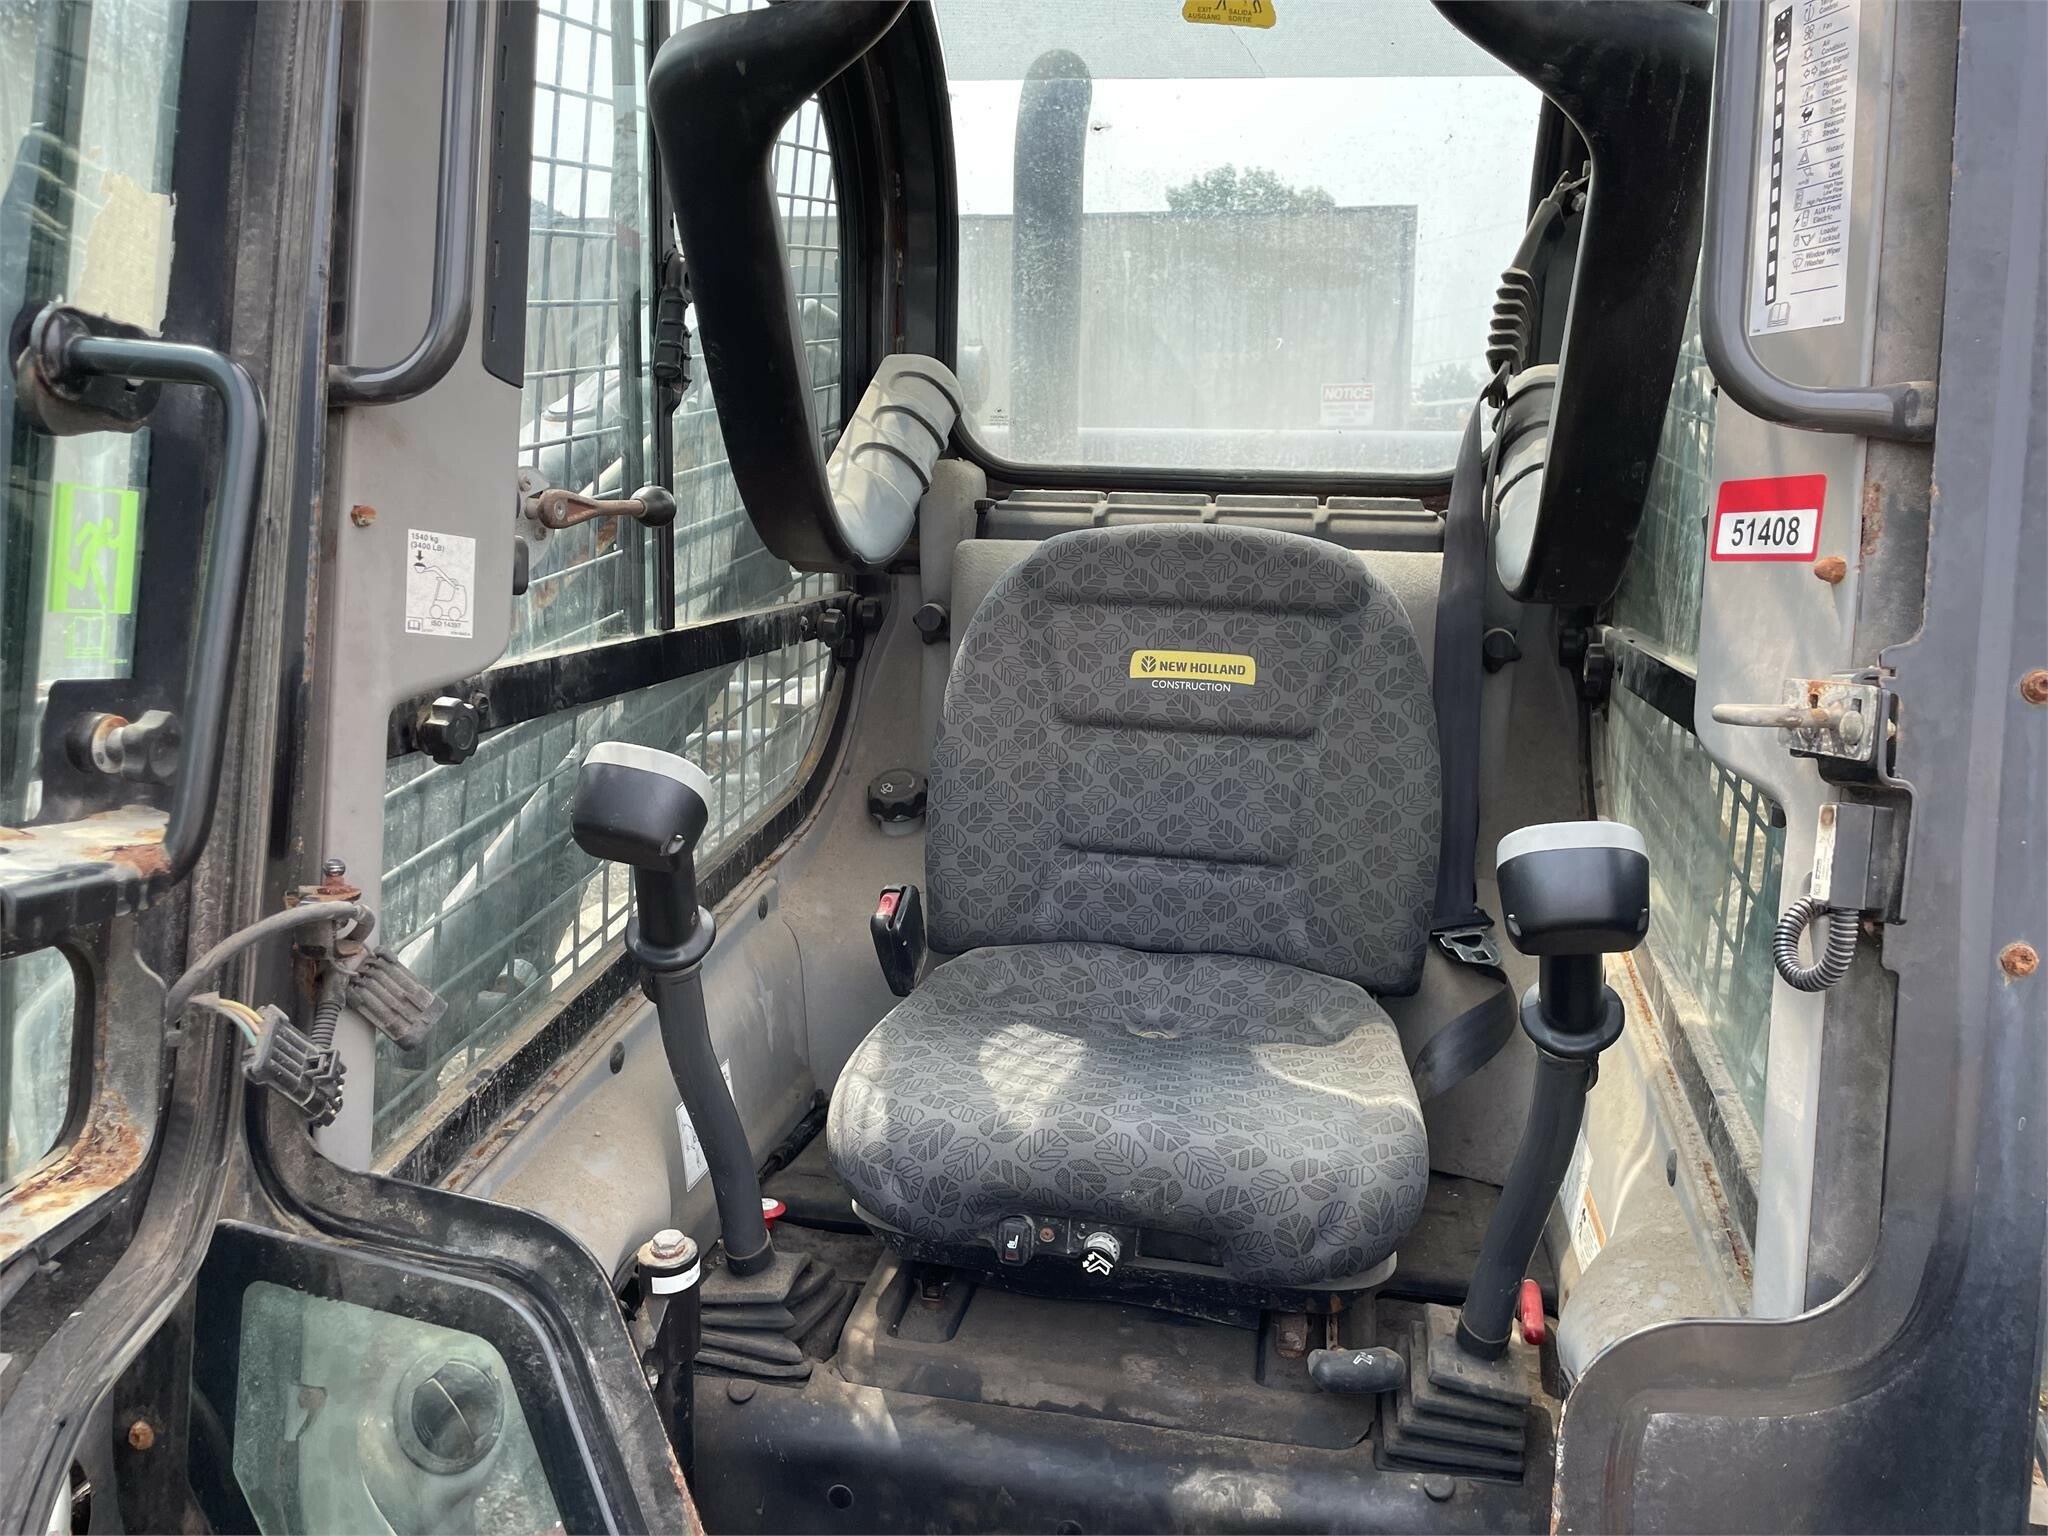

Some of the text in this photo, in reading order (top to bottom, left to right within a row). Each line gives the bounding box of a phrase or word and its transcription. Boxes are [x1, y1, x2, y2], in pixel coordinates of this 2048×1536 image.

[1823, 128, 1839, 138] Strobe
[1826, 142, 1844, 153] Hazard
[1829, 169, 1842, 178] Level
[1814, 206, 1826, 215] AUX
[1813, 214, 1832, 223] Electric
[1820, 226, 1839, 235] Loader
[1819, 234, 1840, 243] Lockout
[1806, 248, 1840, 259] Window Wiper
[1324, 387, 1371, 400] NOTICE
[1731, 516, 1800, 547] 51408
[411, 533, 438, 544] 1540 kg
[411, 542, 431, 550] (3400
[1160, 661, 1246, 675] NEW HOLLAND
[1151, 680, 1231, 692] CONSTRUCTION
